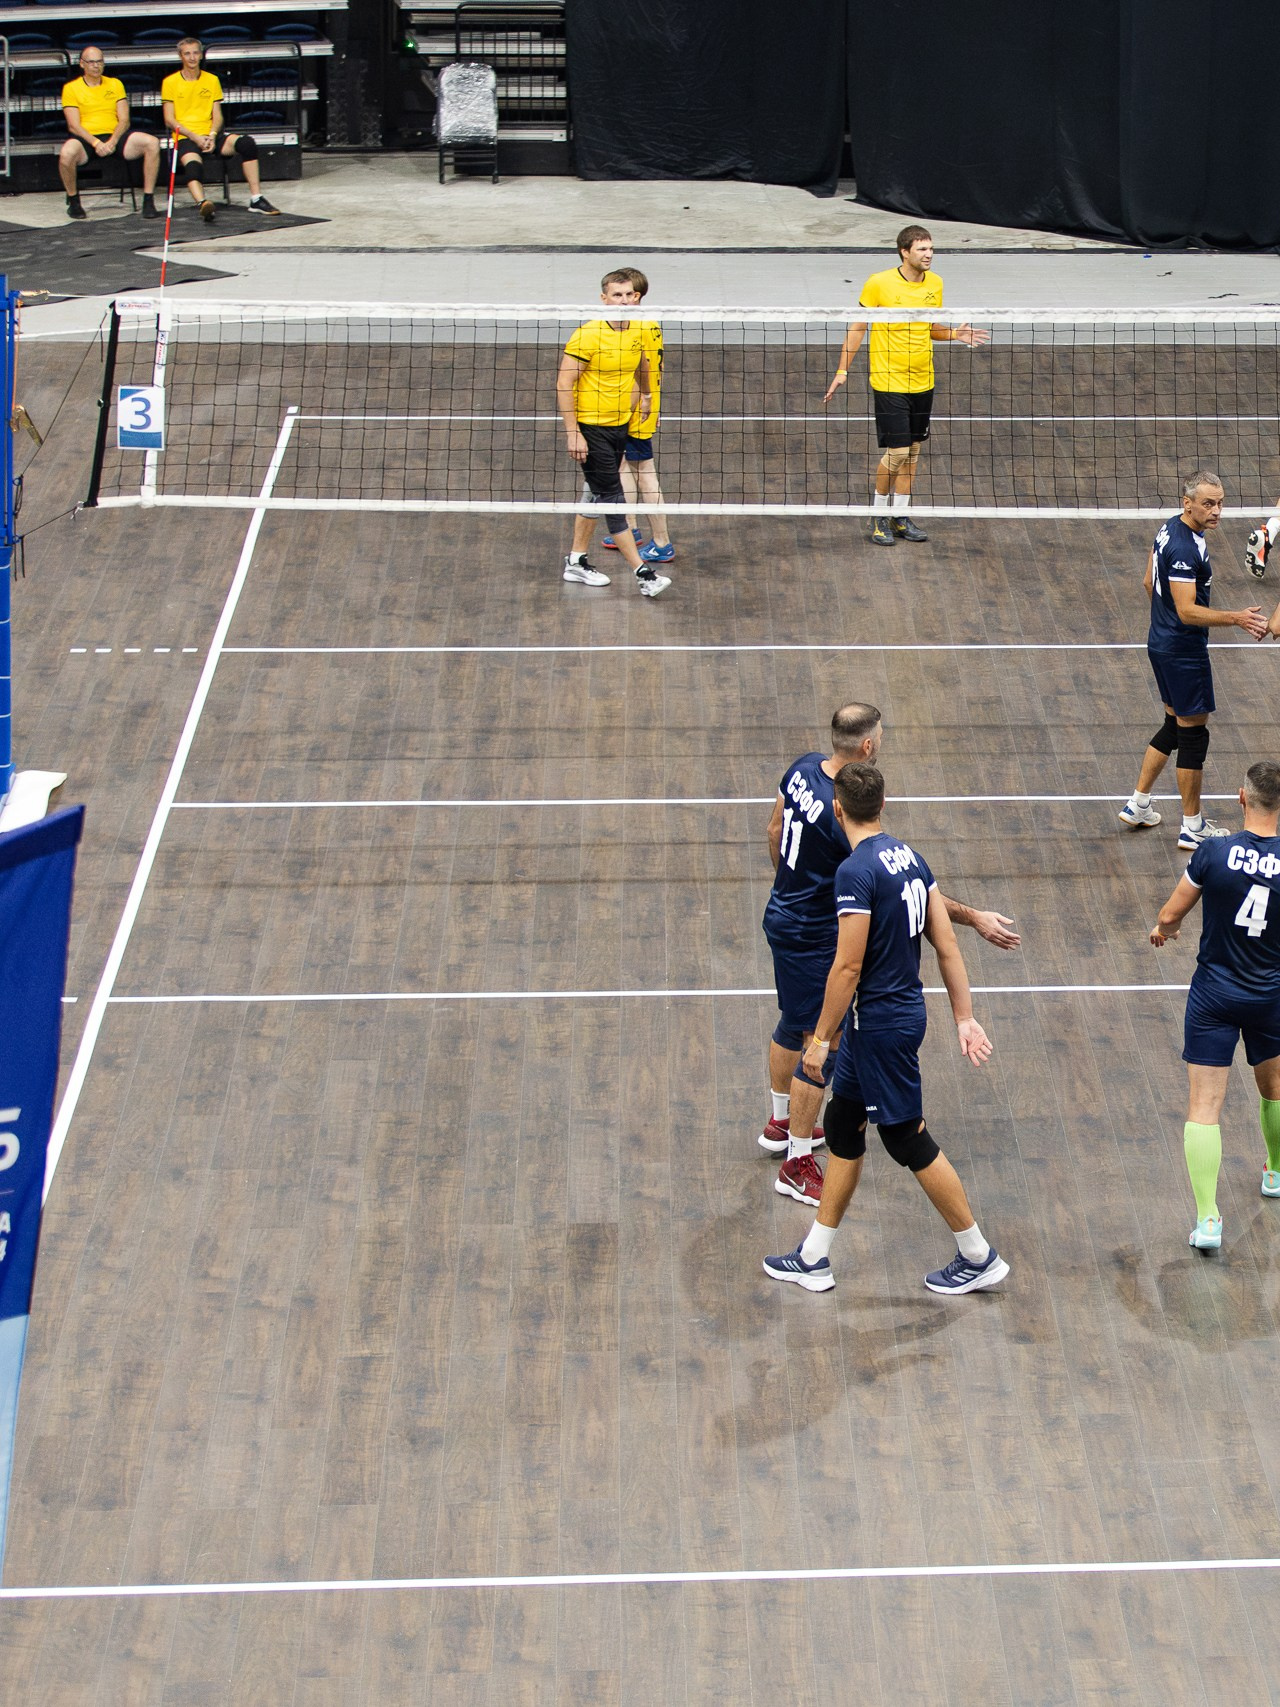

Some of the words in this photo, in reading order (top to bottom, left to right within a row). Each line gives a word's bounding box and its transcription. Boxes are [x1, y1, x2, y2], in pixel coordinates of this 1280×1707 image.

[130, 397, 152, 430] 3
[787, 770, 825, 824] СЗФО
[780, 807, 804, 871] 11
[901, 878, 928, 938] 10
[1234, 884, 1271, 938] 4
